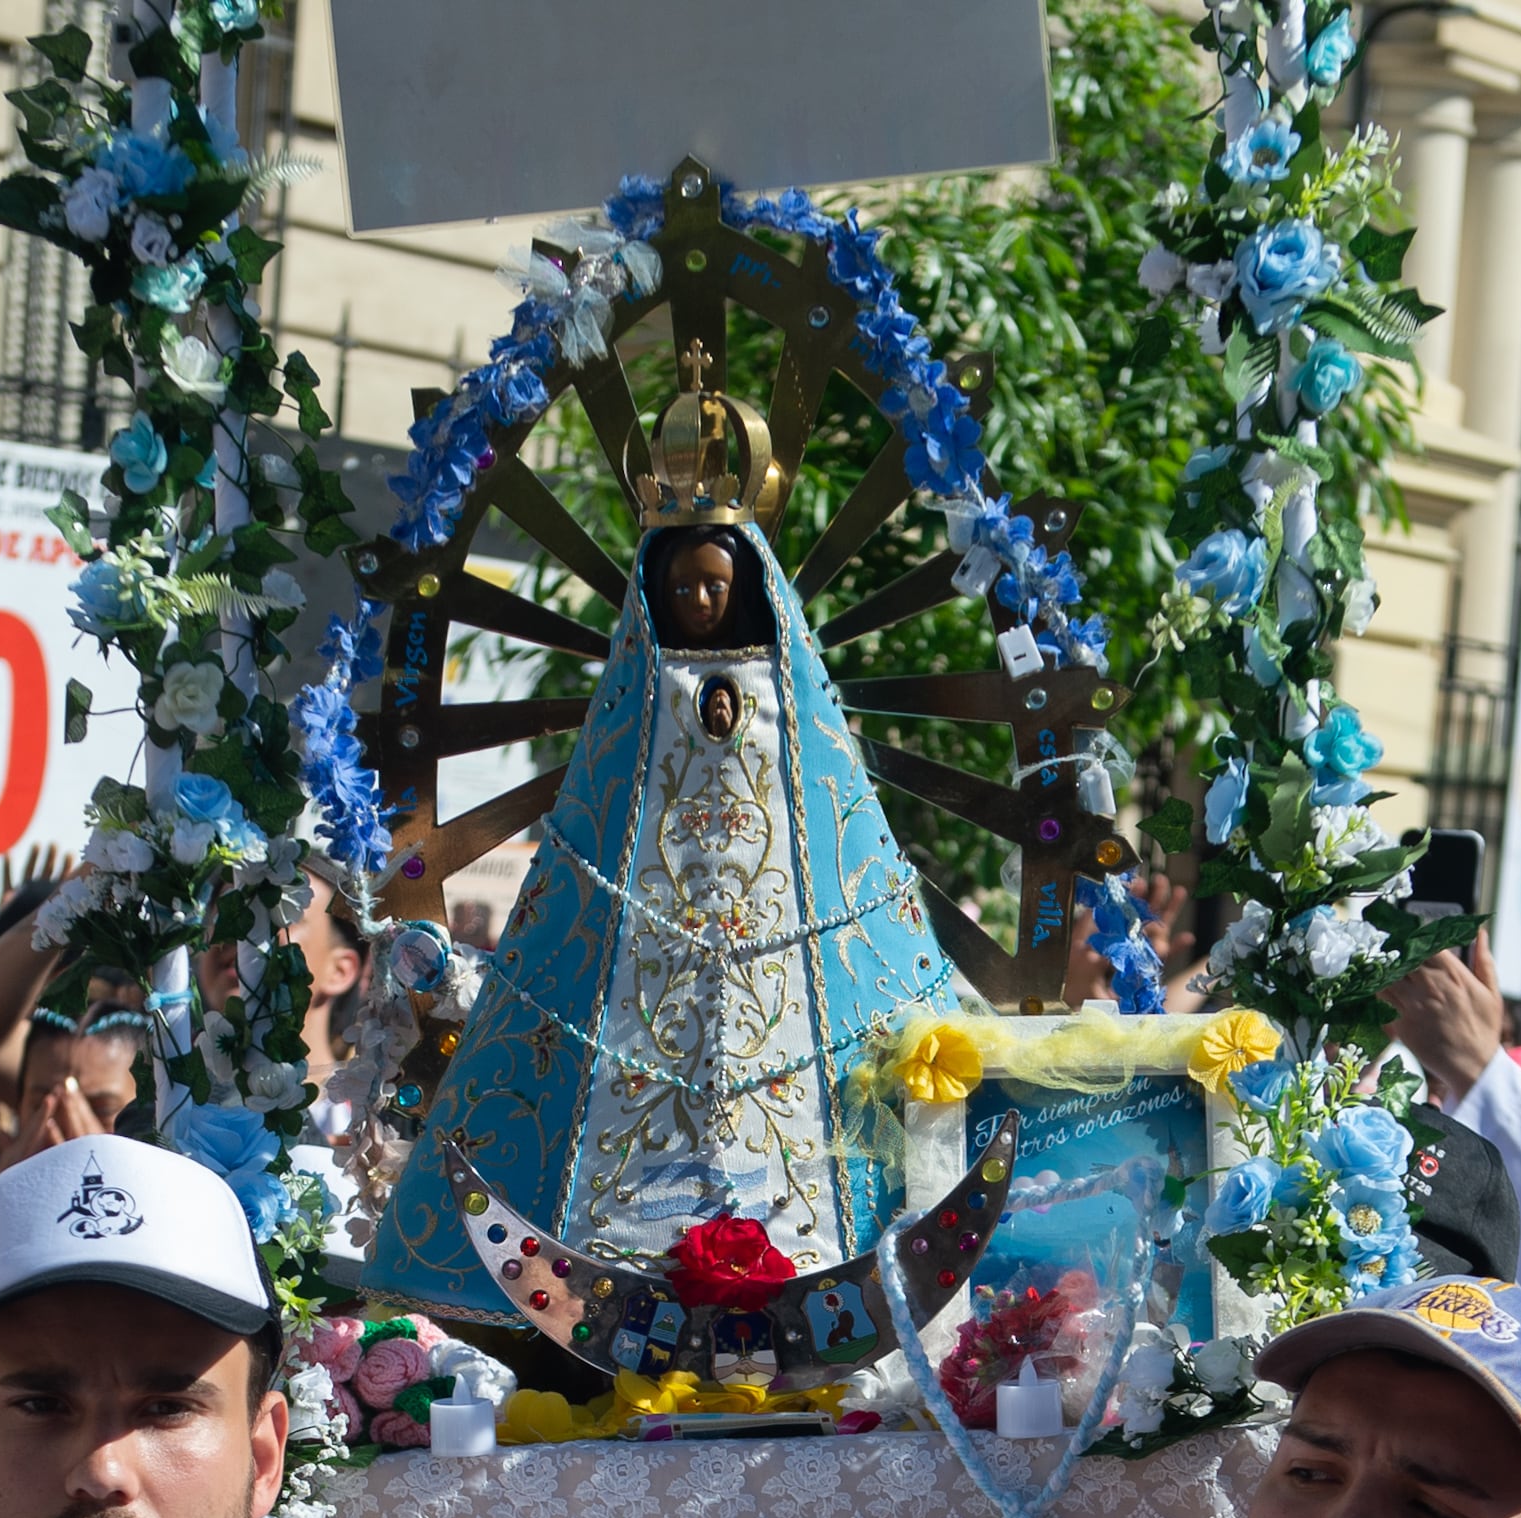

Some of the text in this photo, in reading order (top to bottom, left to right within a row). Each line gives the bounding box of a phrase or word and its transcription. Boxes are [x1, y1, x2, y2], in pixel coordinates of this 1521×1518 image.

[1037, 1088, 1123, 1124] siempre
[1127, 1075, 1151, 1096] en
[1426, 1144, 1447, 1159] AS
[1400, 1289, 1511, 1335] LAKERS
